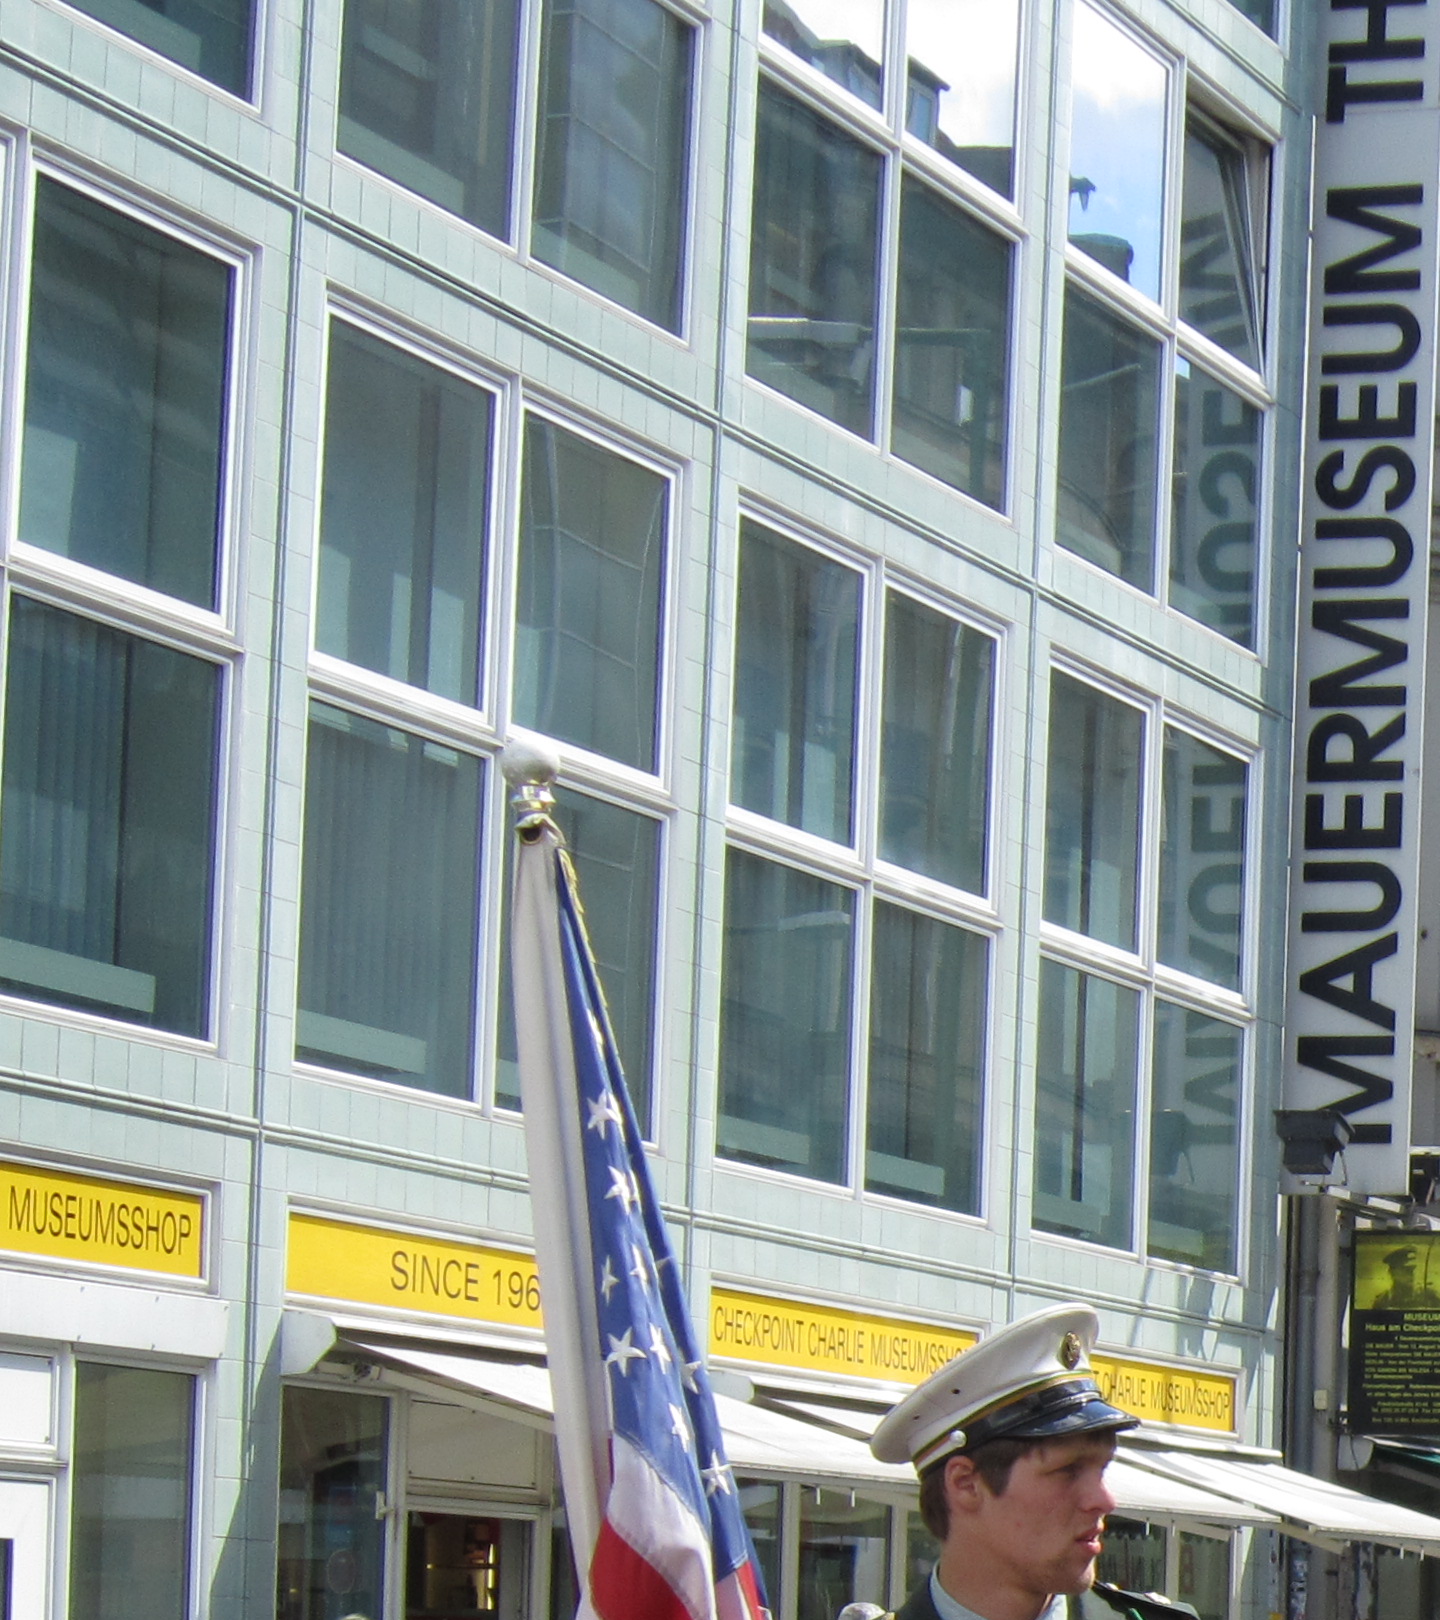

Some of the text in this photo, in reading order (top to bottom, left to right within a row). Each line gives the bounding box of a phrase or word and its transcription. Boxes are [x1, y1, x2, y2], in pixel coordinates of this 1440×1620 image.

[1297, 183, 1424, 1144] MAUERMUSEUM
[9, 1185, 192, 1255] MUSEUMSSHOP
[390, 1250, 541, 1311] SINCE 196
[713, 1305, 804, 1353] CHECKPOINT
[808, 1322, 864, 1364] CHARLIE
[1102, 1372, 1146, 1408] CHARLIE
[1150, 1380, 1230, 1419] MUSEUMSSHOP
